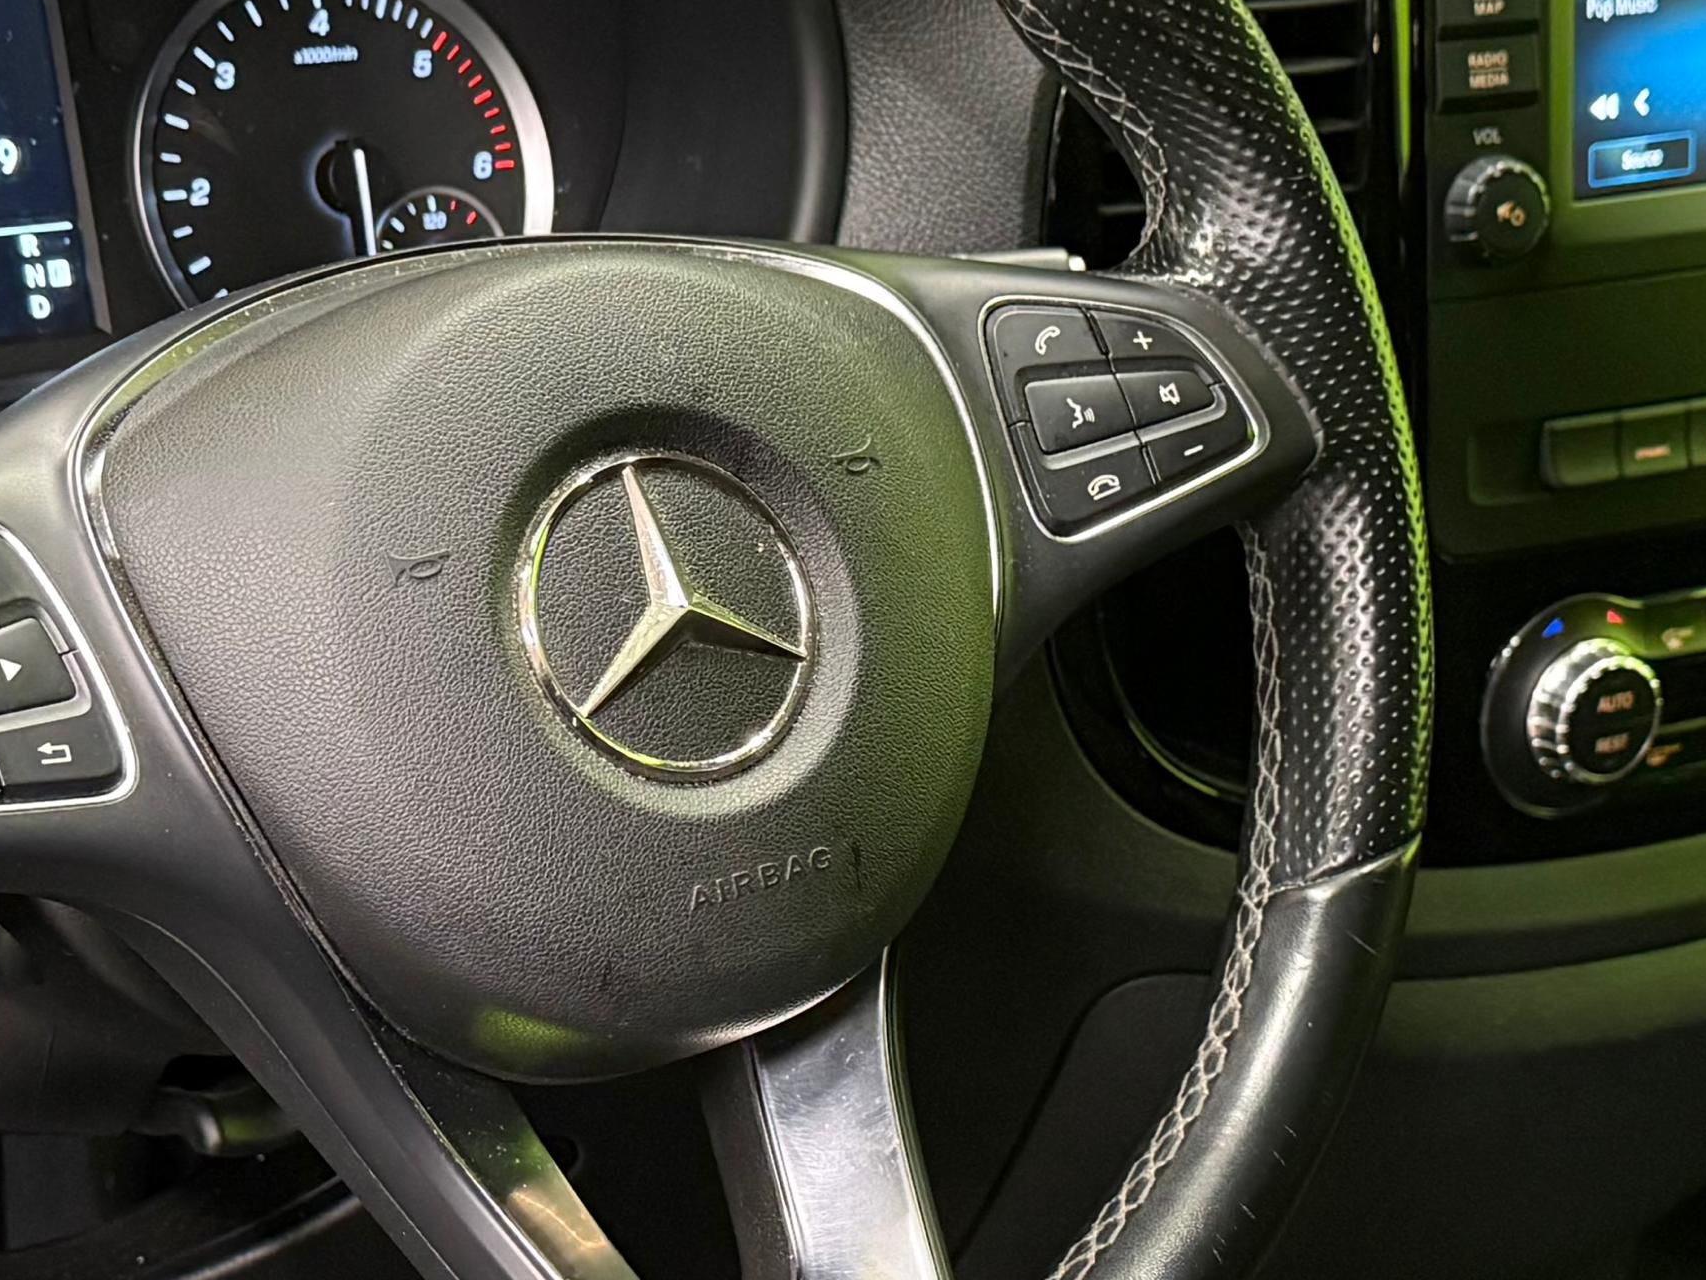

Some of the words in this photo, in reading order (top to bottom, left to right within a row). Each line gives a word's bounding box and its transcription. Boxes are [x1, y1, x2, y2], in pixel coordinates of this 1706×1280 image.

[1473, 0, 1506, 17] MAP
[308, 8, 330, 37] 4
[412, 49, 433, 78] 5
[1468, 50, 1509, 69] RADIO
[214, 61, 236, 90] 3
[1469, 71, 1510, 90] MEDIA
[1473, 127, 1502, 146] VOL
[473, 151, 493, 180] 6
[189, 177, 211, 206] 2
[19, 233, 41, 258] R
[24, 263, 46, 289] N
[29, 294, 51, 319] D
[1596, 690, 1635, 714] AUTO
[691, 846, 832, 911] AIRBAG
